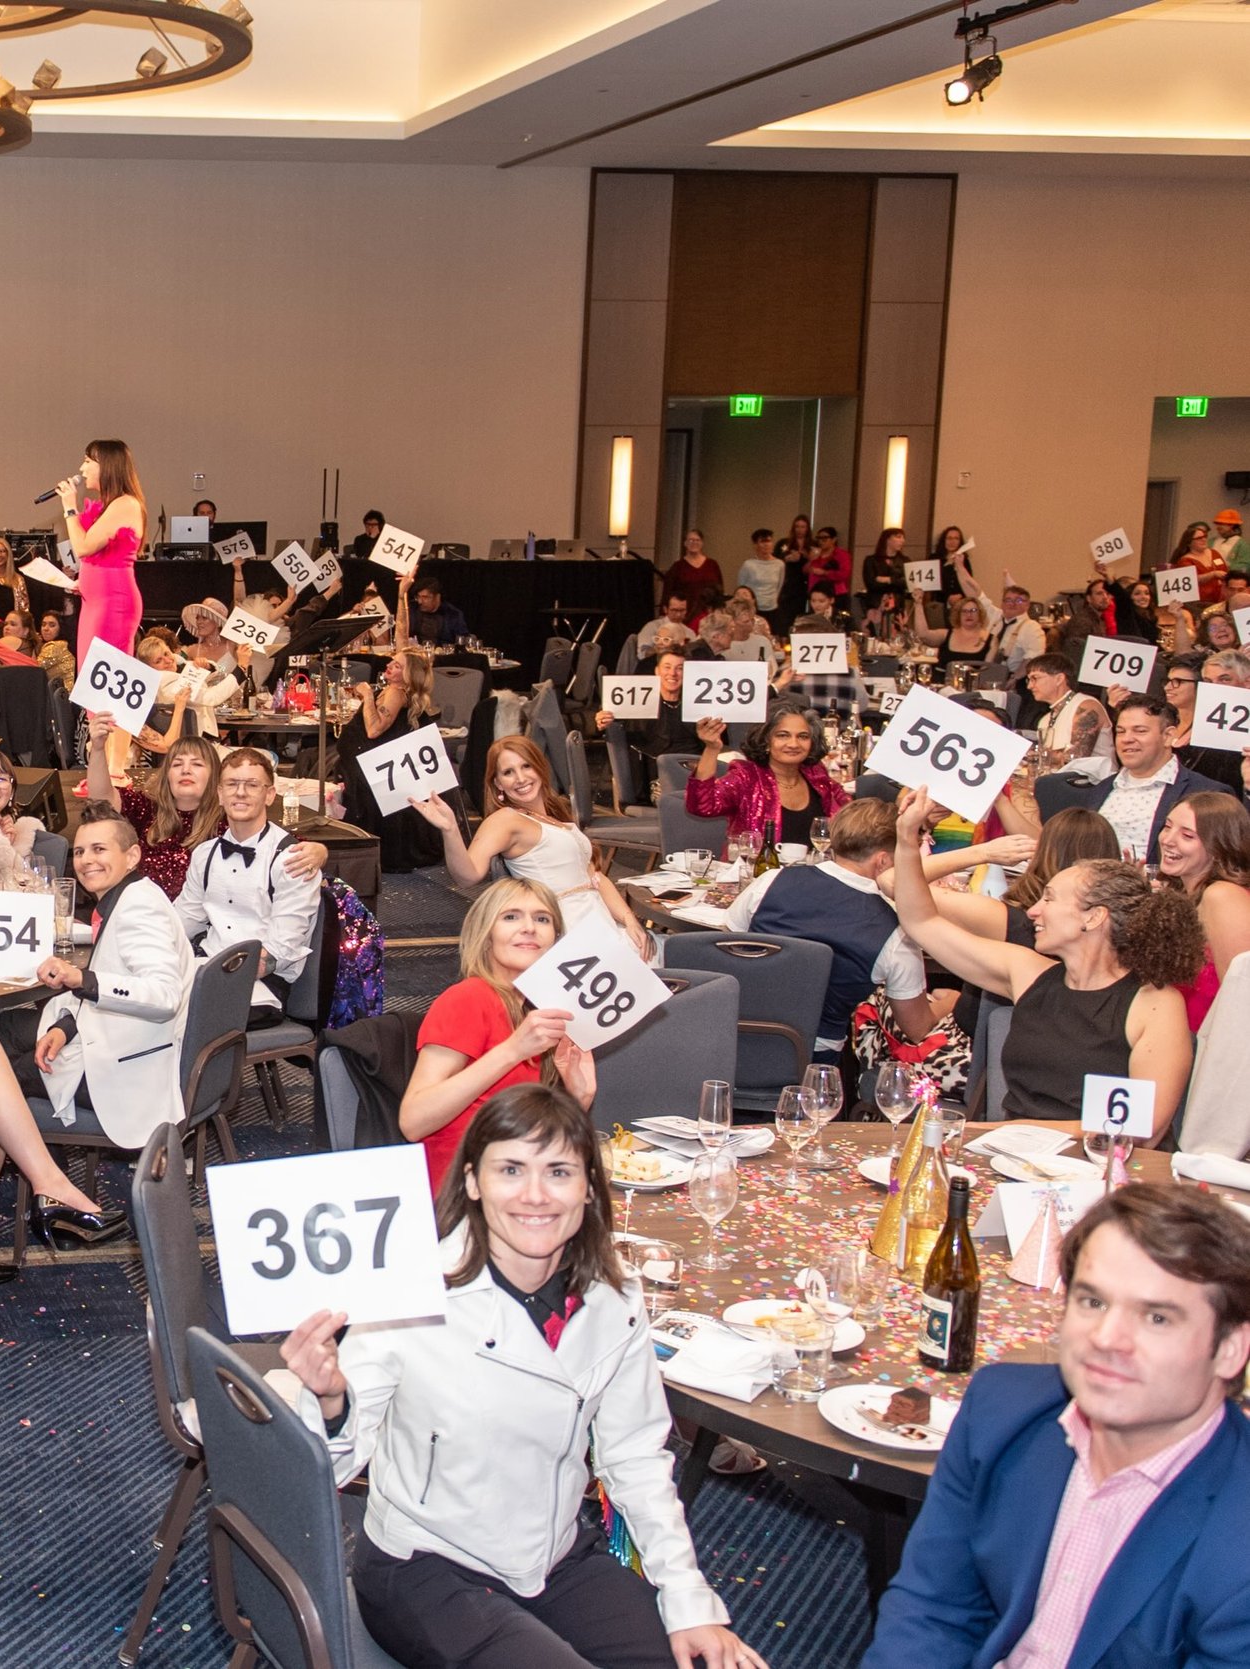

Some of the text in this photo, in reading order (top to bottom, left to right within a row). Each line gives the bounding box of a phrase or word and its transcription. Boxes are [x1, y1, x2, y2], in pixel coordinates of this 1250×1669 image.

[736, 397, 758, 413] EXIT
[1182, 399, 1203, 415] EXIT
[221, 539, 249, 555] 575
[385, 538, 416, 562] 547
[1095, 537, 1124, 558] 380
[283, 553, 310, 582] 550
[908, 568, 935, 583] 414
[1162, 576, 1192, 595] 448
[231, 618, 268, 645] 236
[798, 645, 838, 663] 277
[1093, 649, 1144, 677] 709
[90, 660, 147, 710] 638
[611, 686, 653, 706] 617
[693, 677, 756, 705] 239
[1206, 702, 1250, 733] 42
[899, 716, 995, 787] 563
[375, 745, 439, 792] 719
[557, 955, 636, 1028] 498
[1107, 1087, 1130, 1125] 6
[247, 1195, 401, 1281] 367
